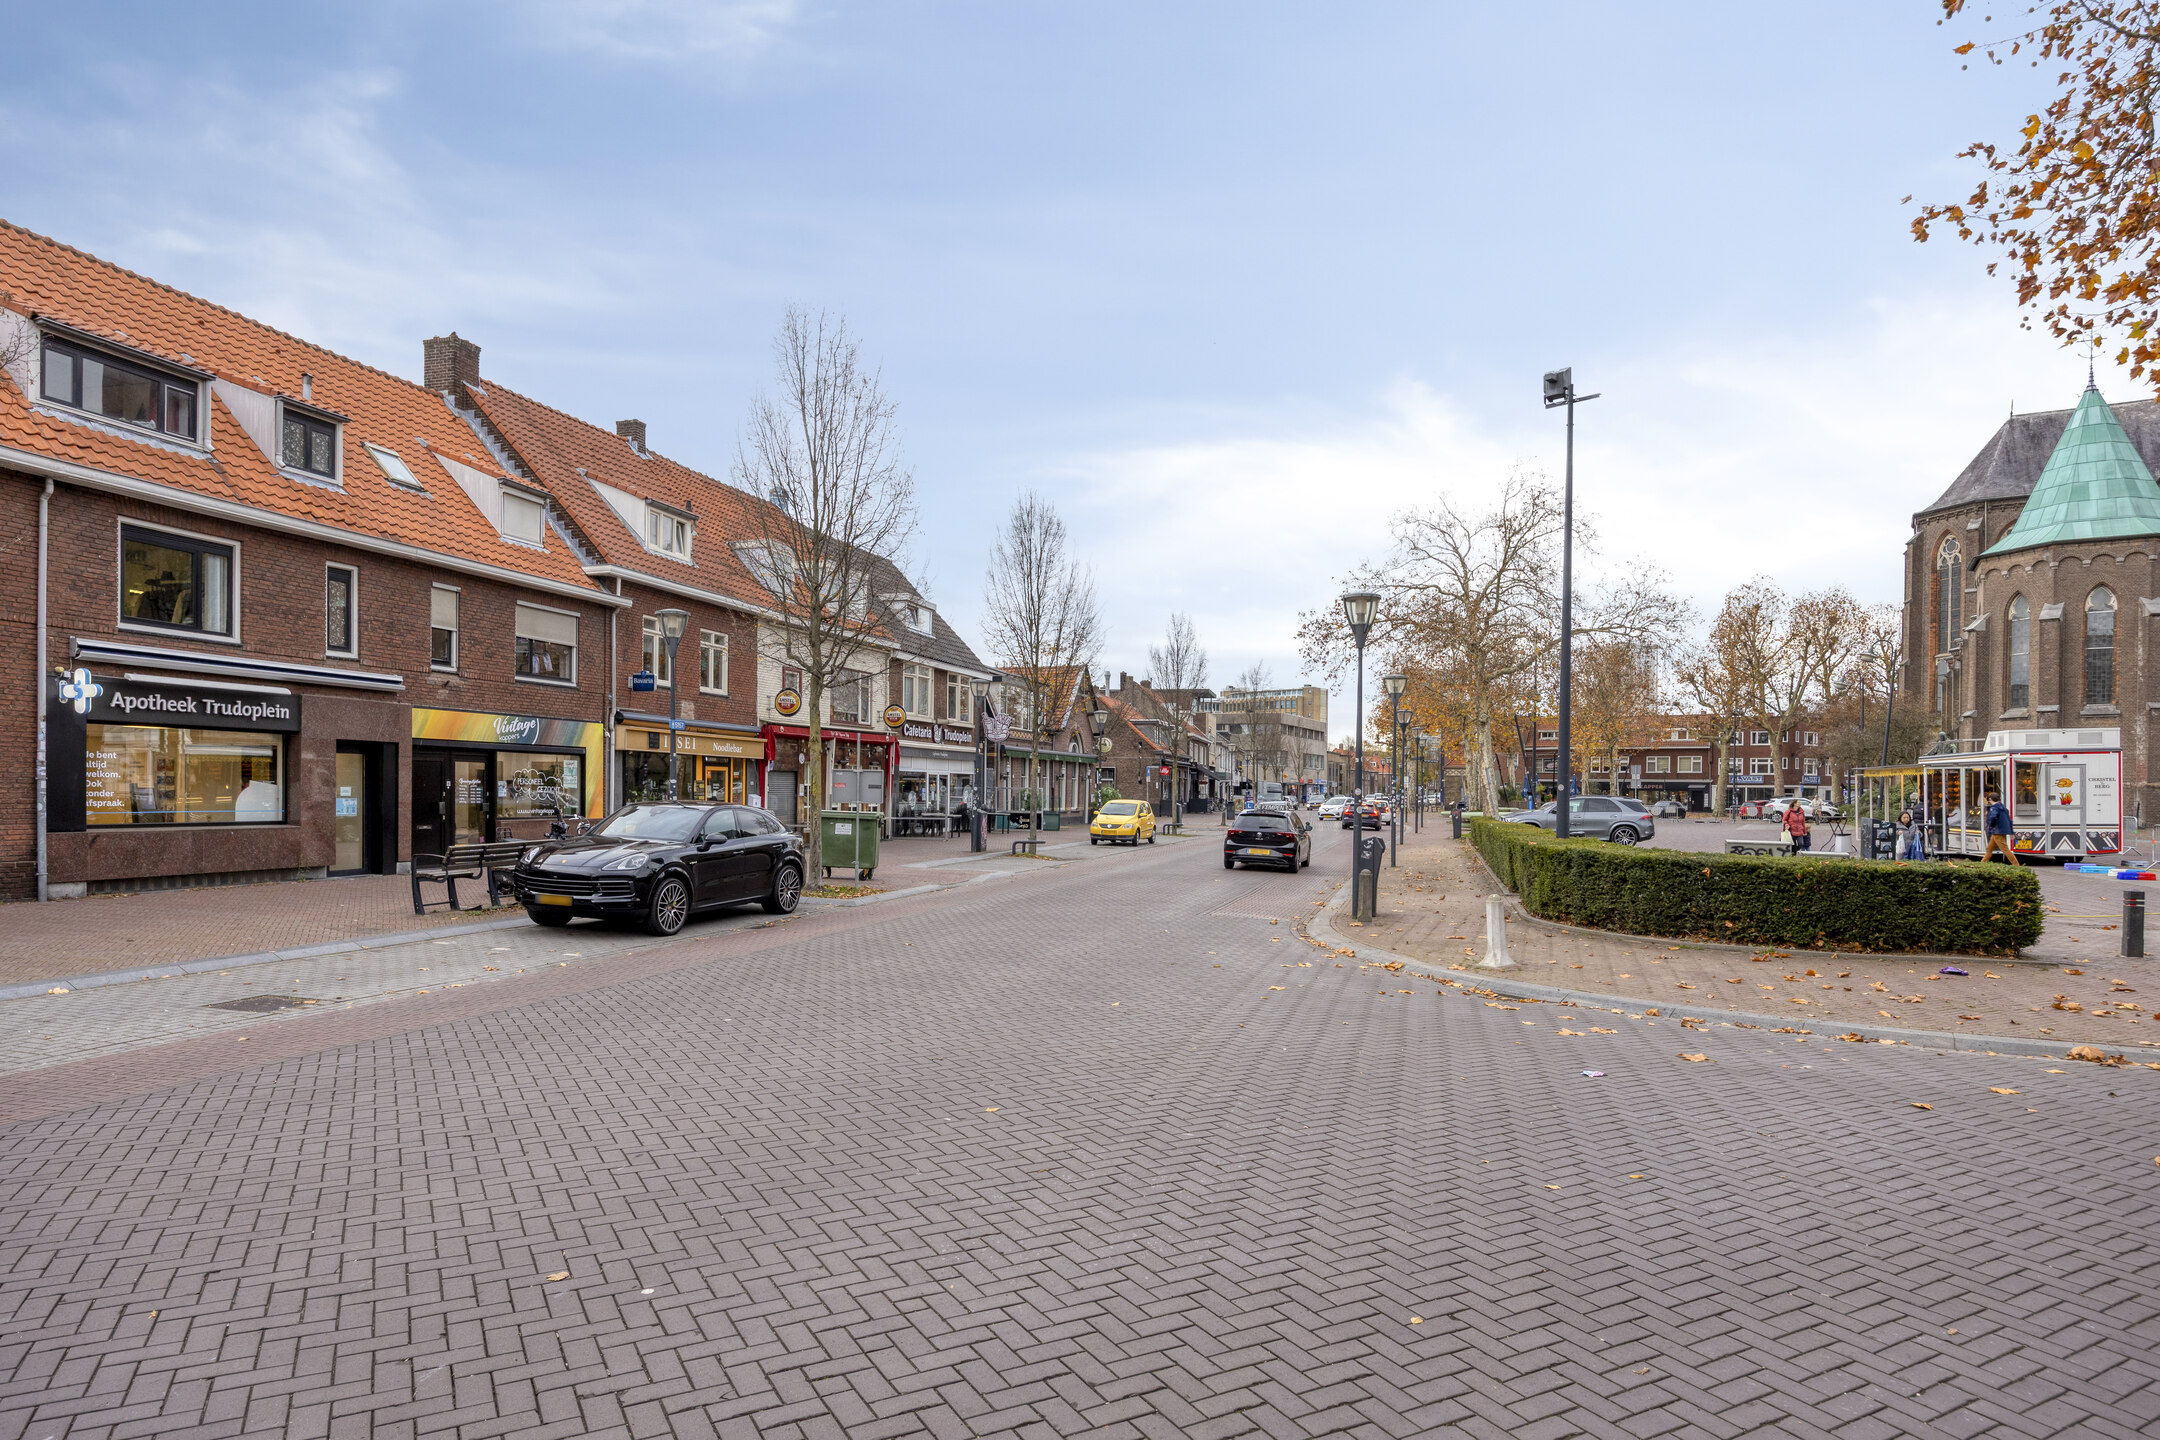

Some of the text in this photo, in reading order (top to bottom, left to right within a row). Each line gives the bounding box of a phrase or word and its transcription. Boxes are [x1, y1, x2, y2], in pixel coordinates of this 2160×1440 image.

[110, 692, 290, 722] Apotheek Trudoplein
[493, 716, 536, 737] Vintage
[904, 724, 972, 744] Cafetaria Trudoplein
[664, 735, 696, 750] ISEI
[712, 742, 742, 753] Noodlebar
[96, 750, 117, 759] bent
